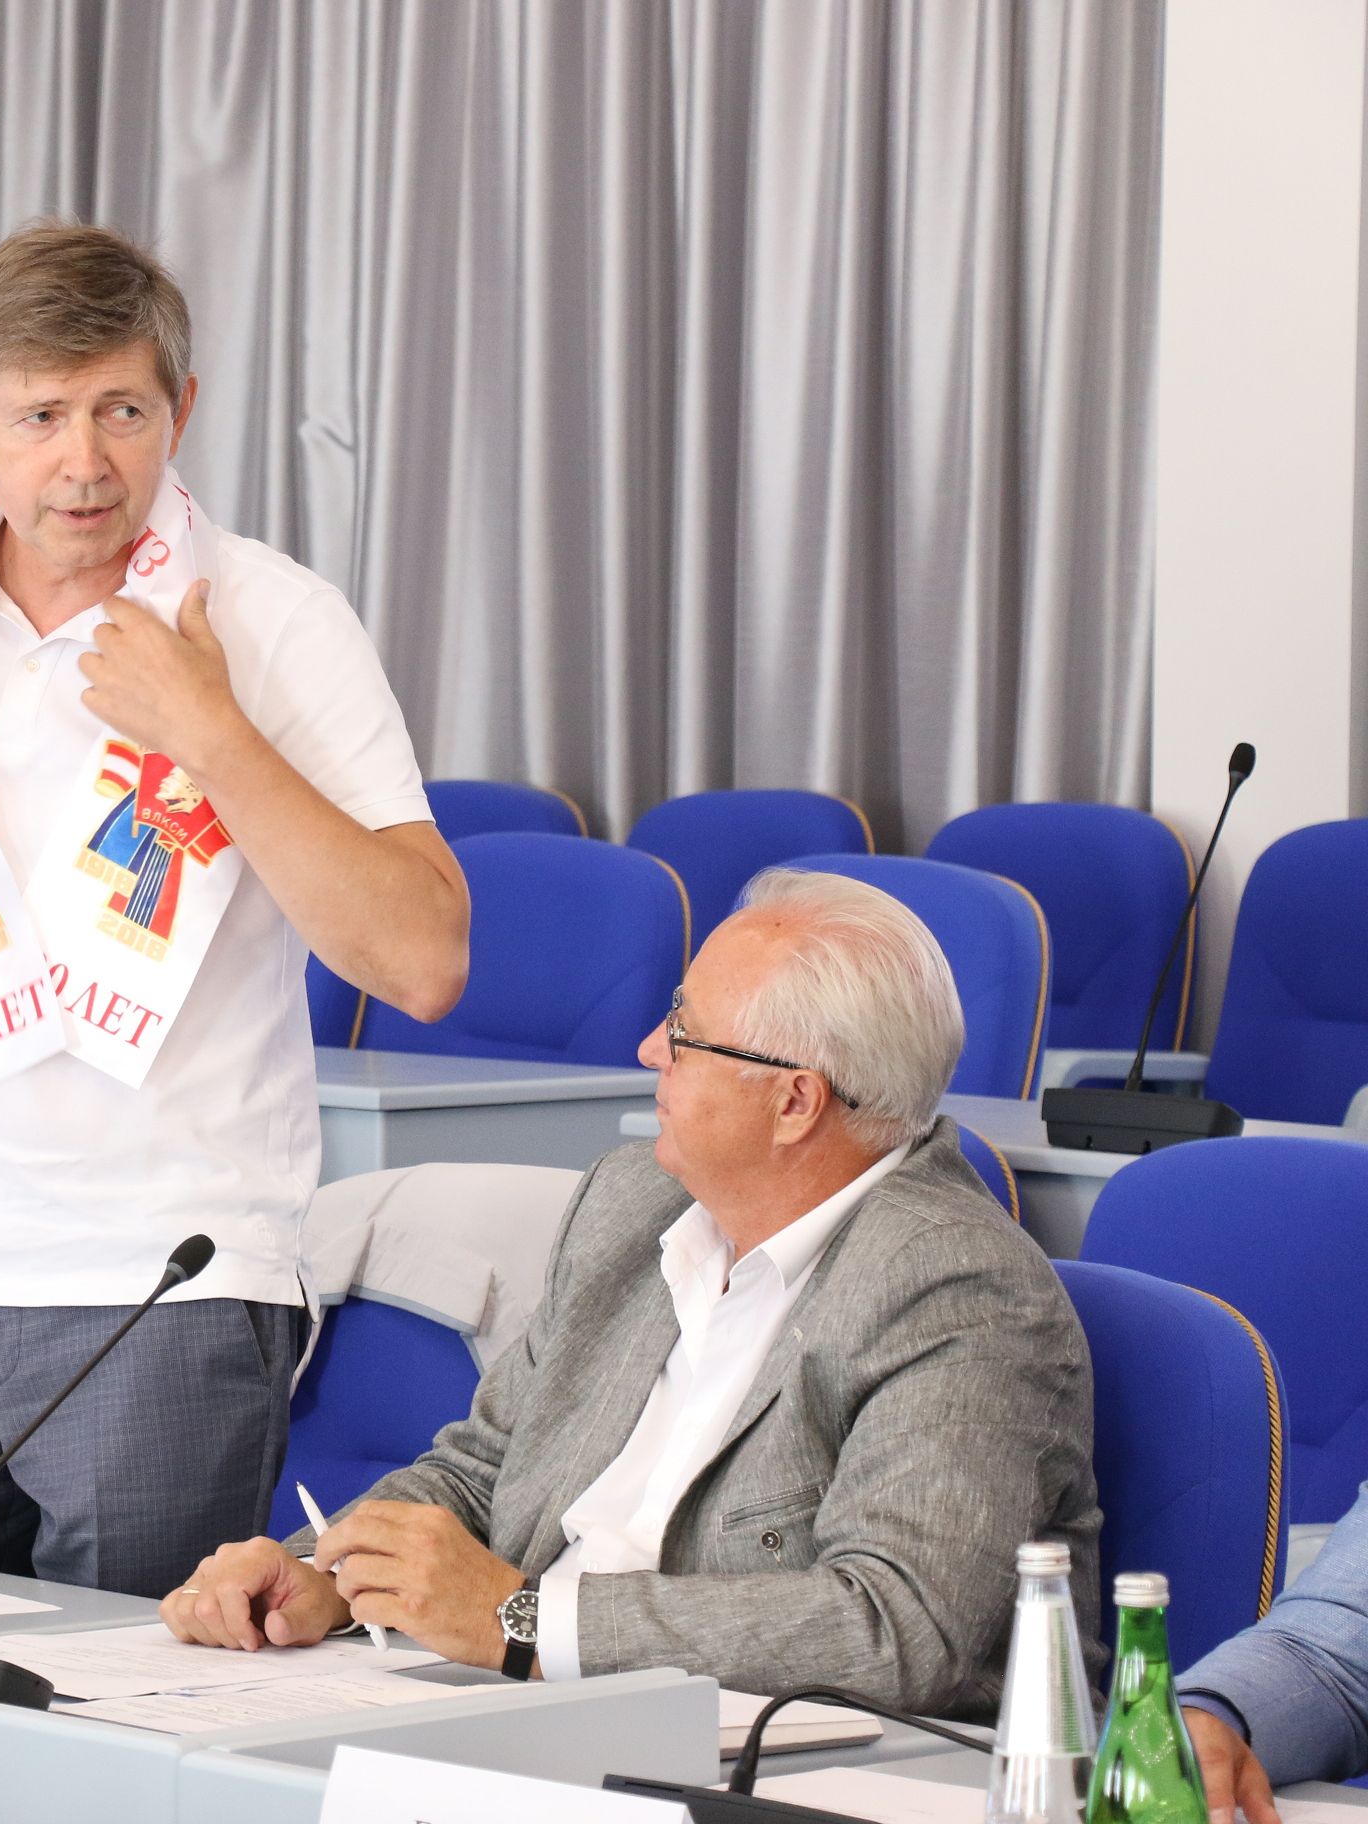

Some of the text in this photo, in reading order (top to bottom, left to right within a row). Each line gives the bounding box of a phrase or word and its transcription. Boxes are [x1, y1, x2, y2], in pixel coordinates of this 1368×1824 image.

[141, 807, 189, 842] ВЛКСМ
[96, 912, 170, 963] 2018
[64, 981, 164, 1049] ЛЕТ
